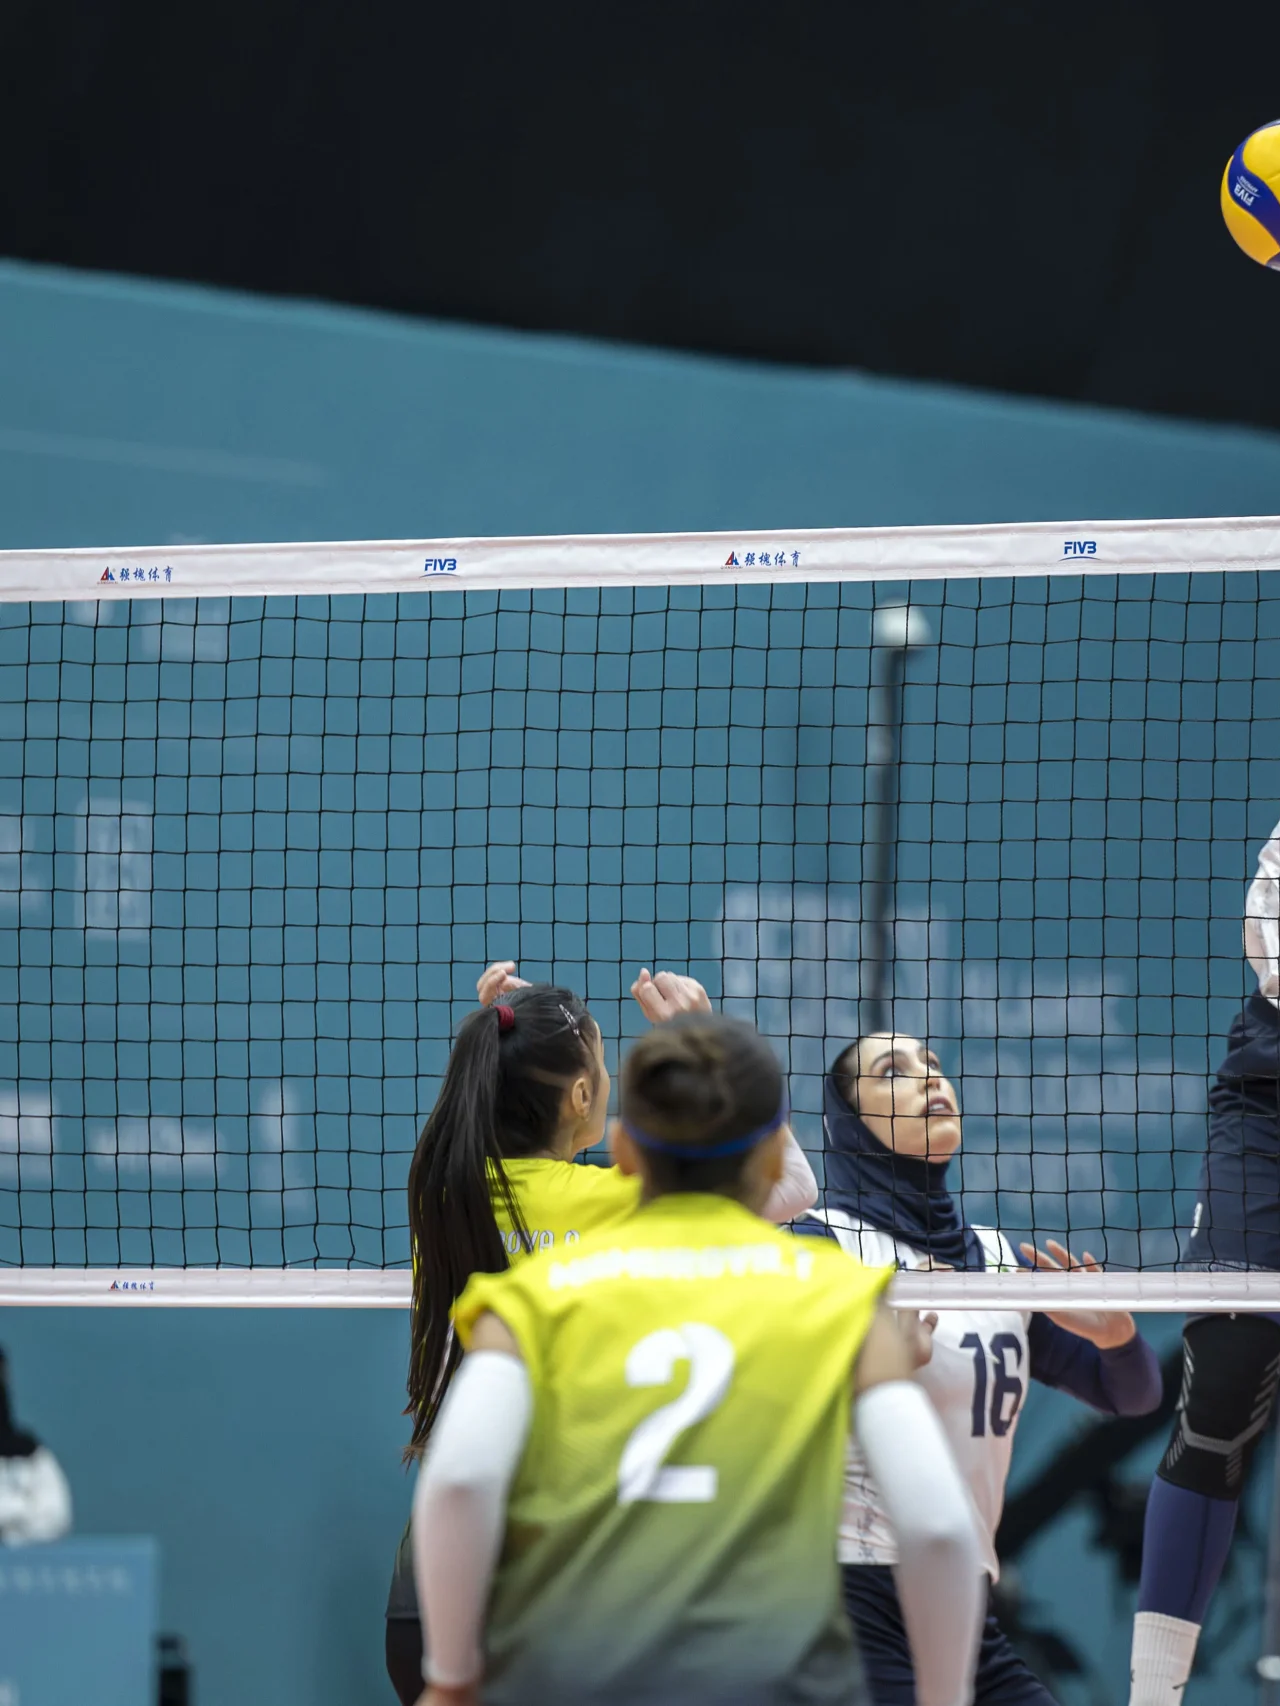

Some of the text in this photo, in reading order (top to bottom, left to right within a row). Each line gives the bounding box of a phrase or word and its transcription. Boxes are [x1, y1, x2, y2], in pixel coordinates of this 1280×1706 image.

[1233, 183, 1255, 206] FIVB
[1063, 541, 1097, 555] FIVB
[424, 558, 457, 571] FIVB
[959, 1332, 1023, 1438] 16
[617, 1322, 737, 1506] 2
